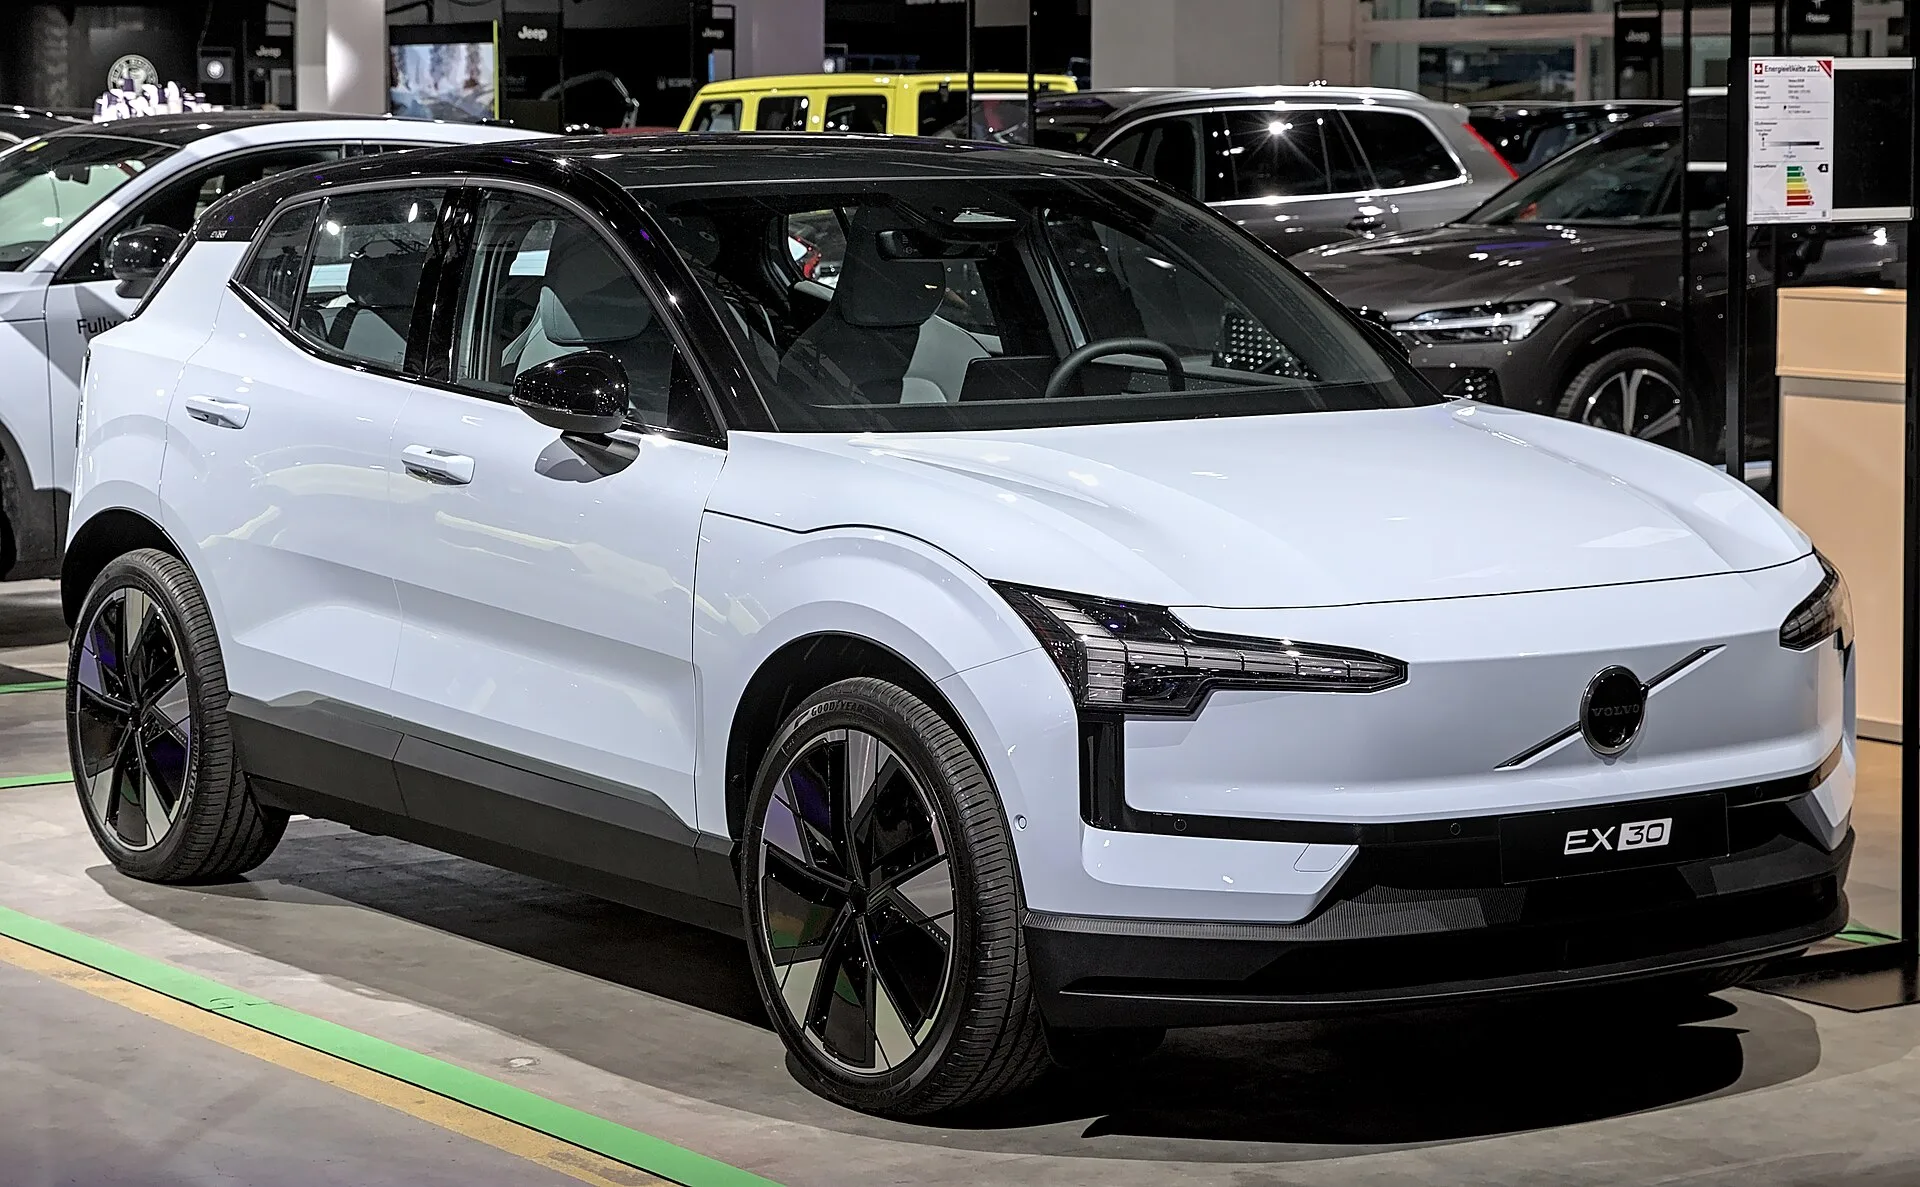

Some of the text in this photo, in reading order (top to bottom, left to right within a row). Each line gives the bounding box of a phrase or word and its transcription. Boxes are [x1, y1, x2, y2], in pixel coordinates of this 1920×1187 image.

[517, 25, 549, 42] Jeep
[701, 26, 725, 40] Jeep
[1625, 29, 1651, 44] Jeep
[255, 44, 282, 59] Jeep
[810, 699, 866, 717] GOODYEAR
[1591, 703, 1641, 718] VOLVO
[1563, 817, 1673, 855] EX30
